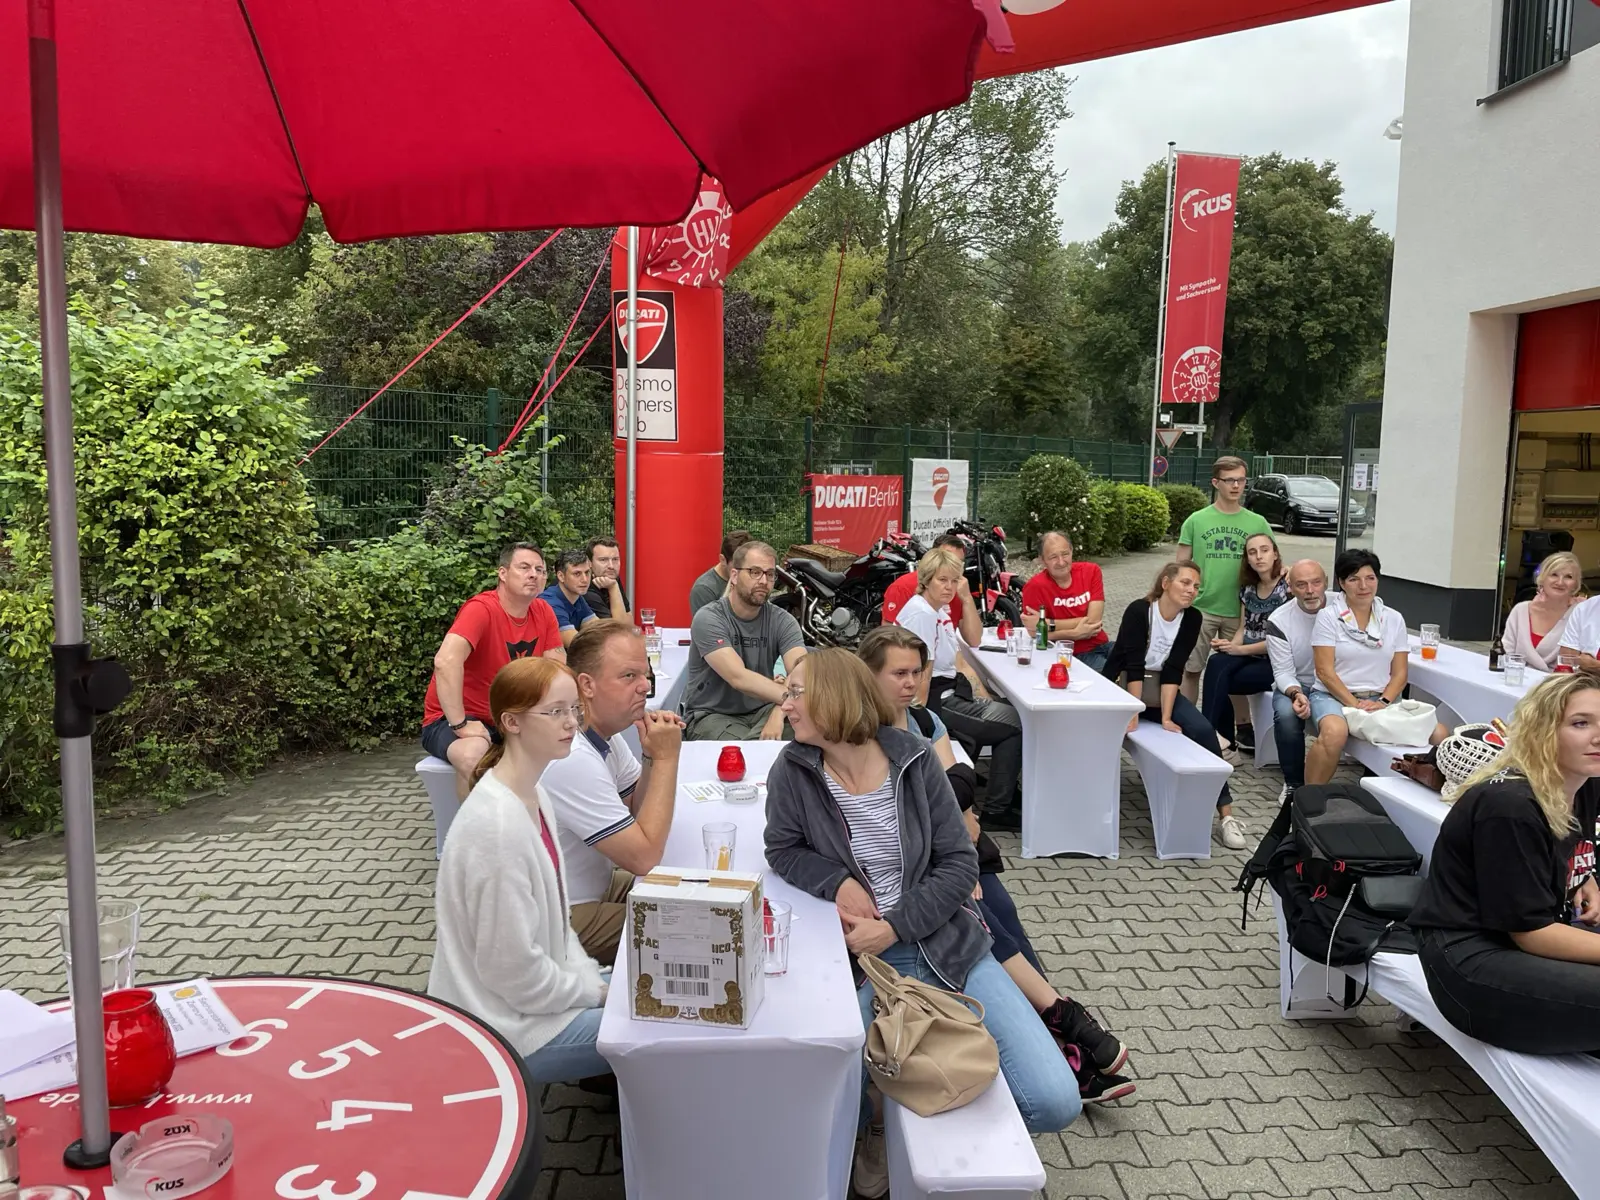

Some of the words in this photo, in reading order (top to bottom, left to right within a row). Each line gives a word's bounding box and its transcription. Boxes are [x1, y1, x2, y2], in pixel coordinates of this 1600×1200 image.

[619, 308, 661, 319] DCATI
[617, 374, 672, 391] Dsmo
[1193, 373, 1207, 387] HU
[617, 394, 673, 413] Oners
[618, 414, 647, 433] Cb
[815, 485, 867, 508] DUCATI
[868, 485, 899, 507] Berlin
[913, 520, 932, 530] Ducati
[933, 517, 951, 529] Official
[1202, 527, 1248, 541] ESTABLISHE
[288, 1039, 382, 1080] 5
[316, 1099, 413, 1131] 4
